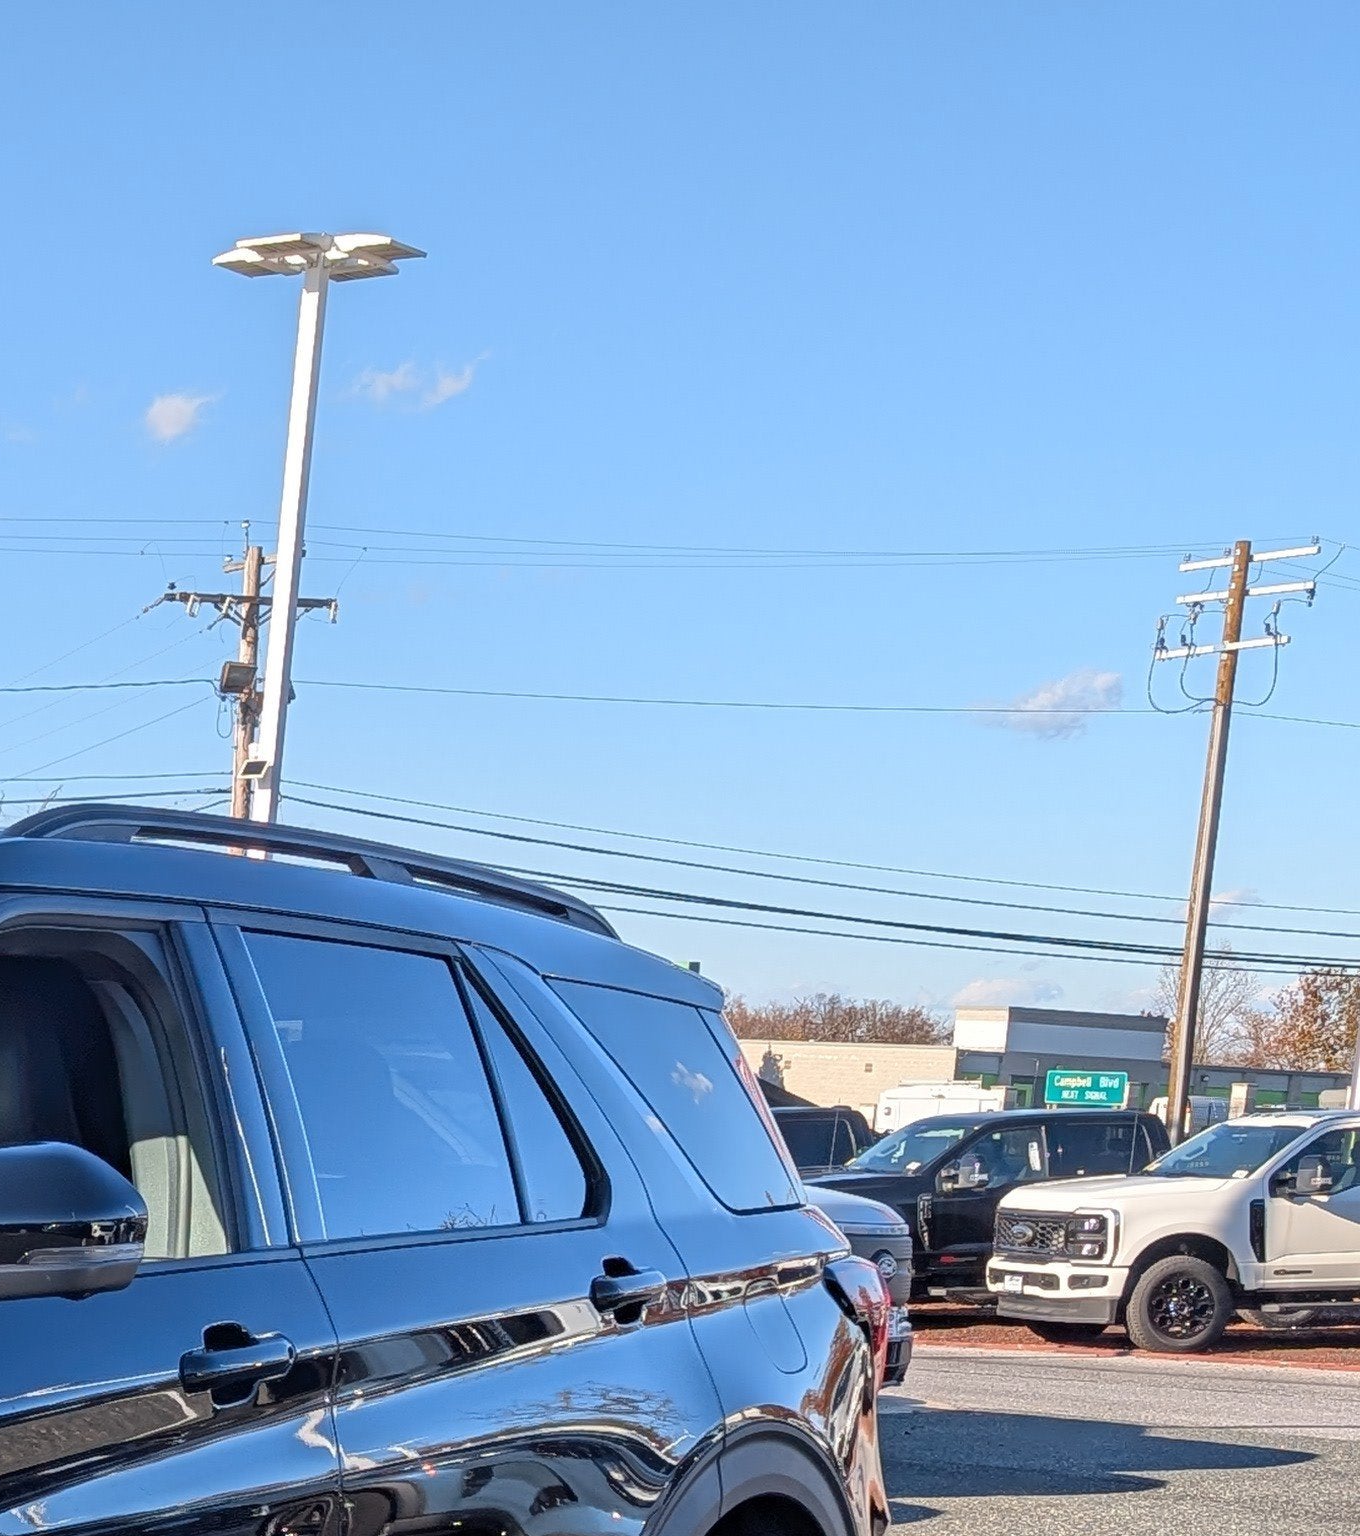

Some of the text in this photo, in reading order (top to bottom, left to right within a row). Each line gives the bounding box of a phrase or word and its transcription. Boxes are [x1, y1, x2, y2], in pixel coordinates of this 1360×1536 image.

[1054, 1075, 1119, 1089] Campbell Blvd
[1061, 1090, 1108, 1101] NEXT SIGNAL
